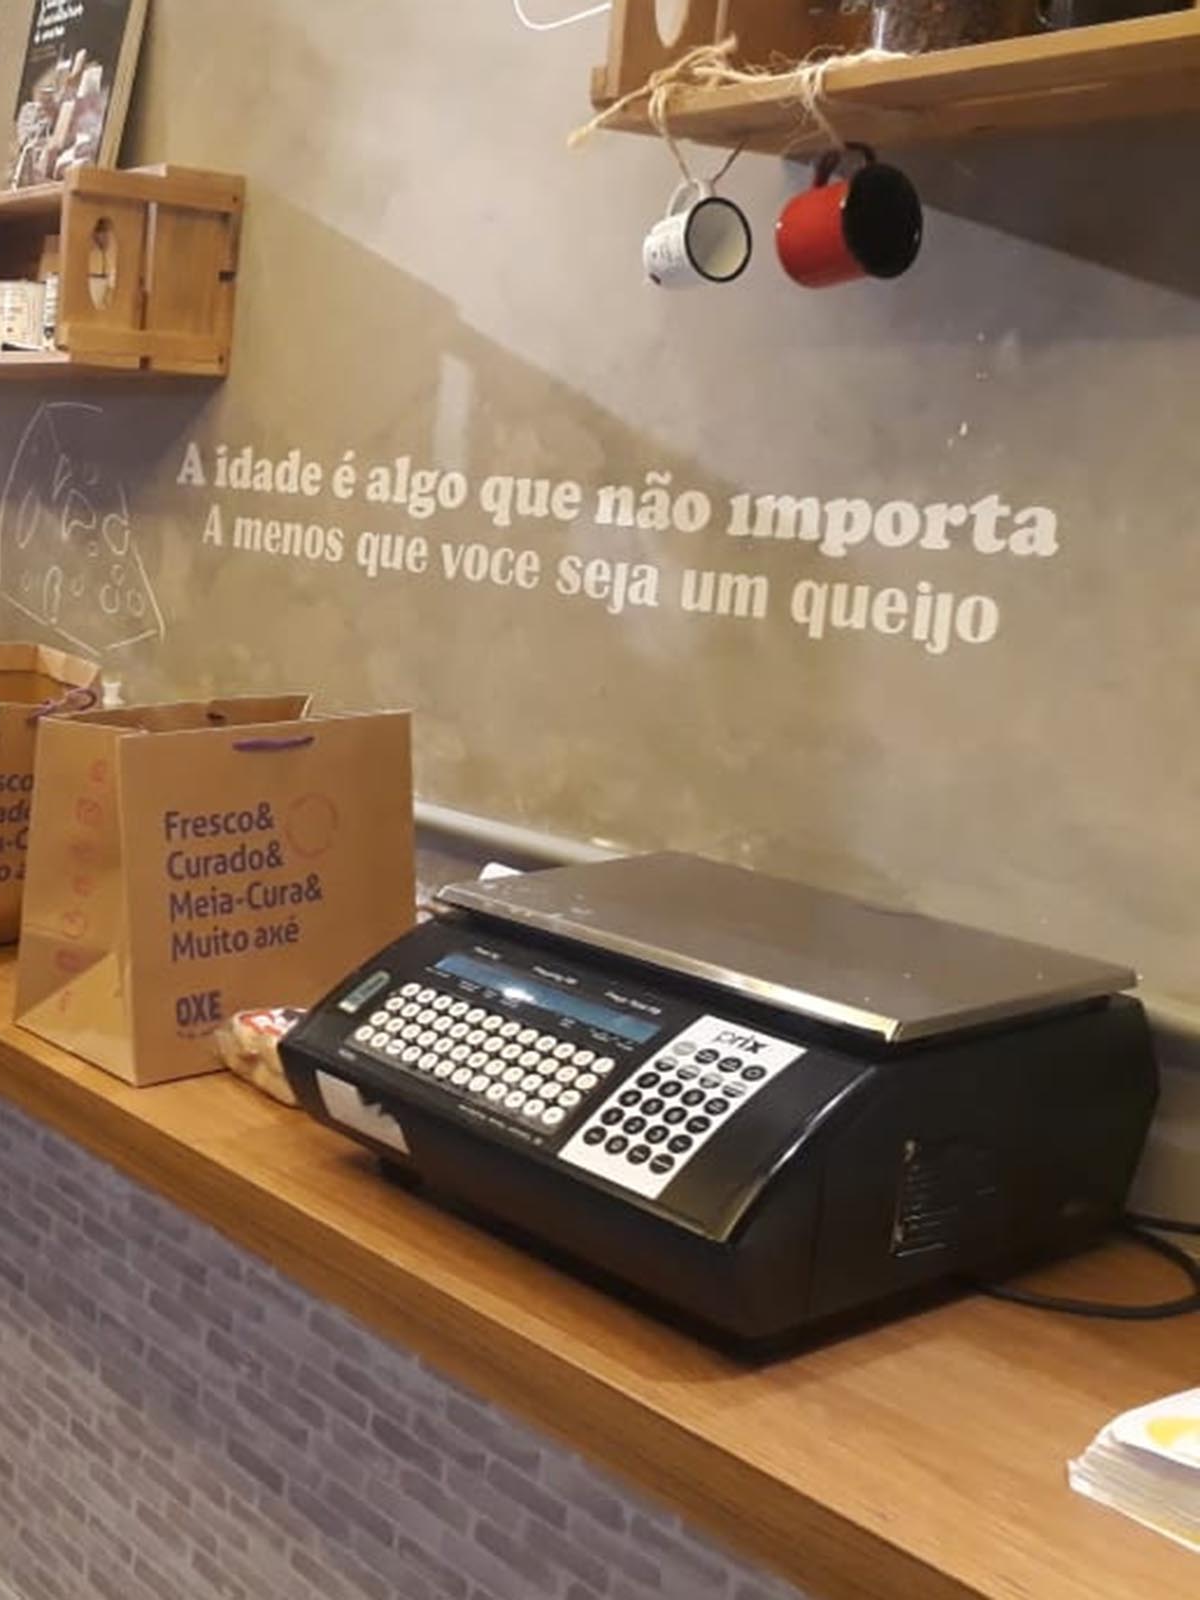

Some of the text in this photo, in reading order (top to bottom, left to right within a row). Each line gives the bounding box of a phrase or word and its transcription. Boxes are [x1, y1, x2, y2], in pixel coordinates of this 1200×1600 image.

[177, 442, 1059, 557] A idade é algo que não importa
[202, 504, 1000, 655] A menos que voce seja um queijo
[164, 801, 274, 841] Fresco&
[166, 841, 284, 881] Curado&
[169, 873, 324, 924] Meia-Cura&
[171, 915, 300, 963] Muito axé
[175, 990, 224, 1027] OXE
[712, 1031, 769, 1055] prix
